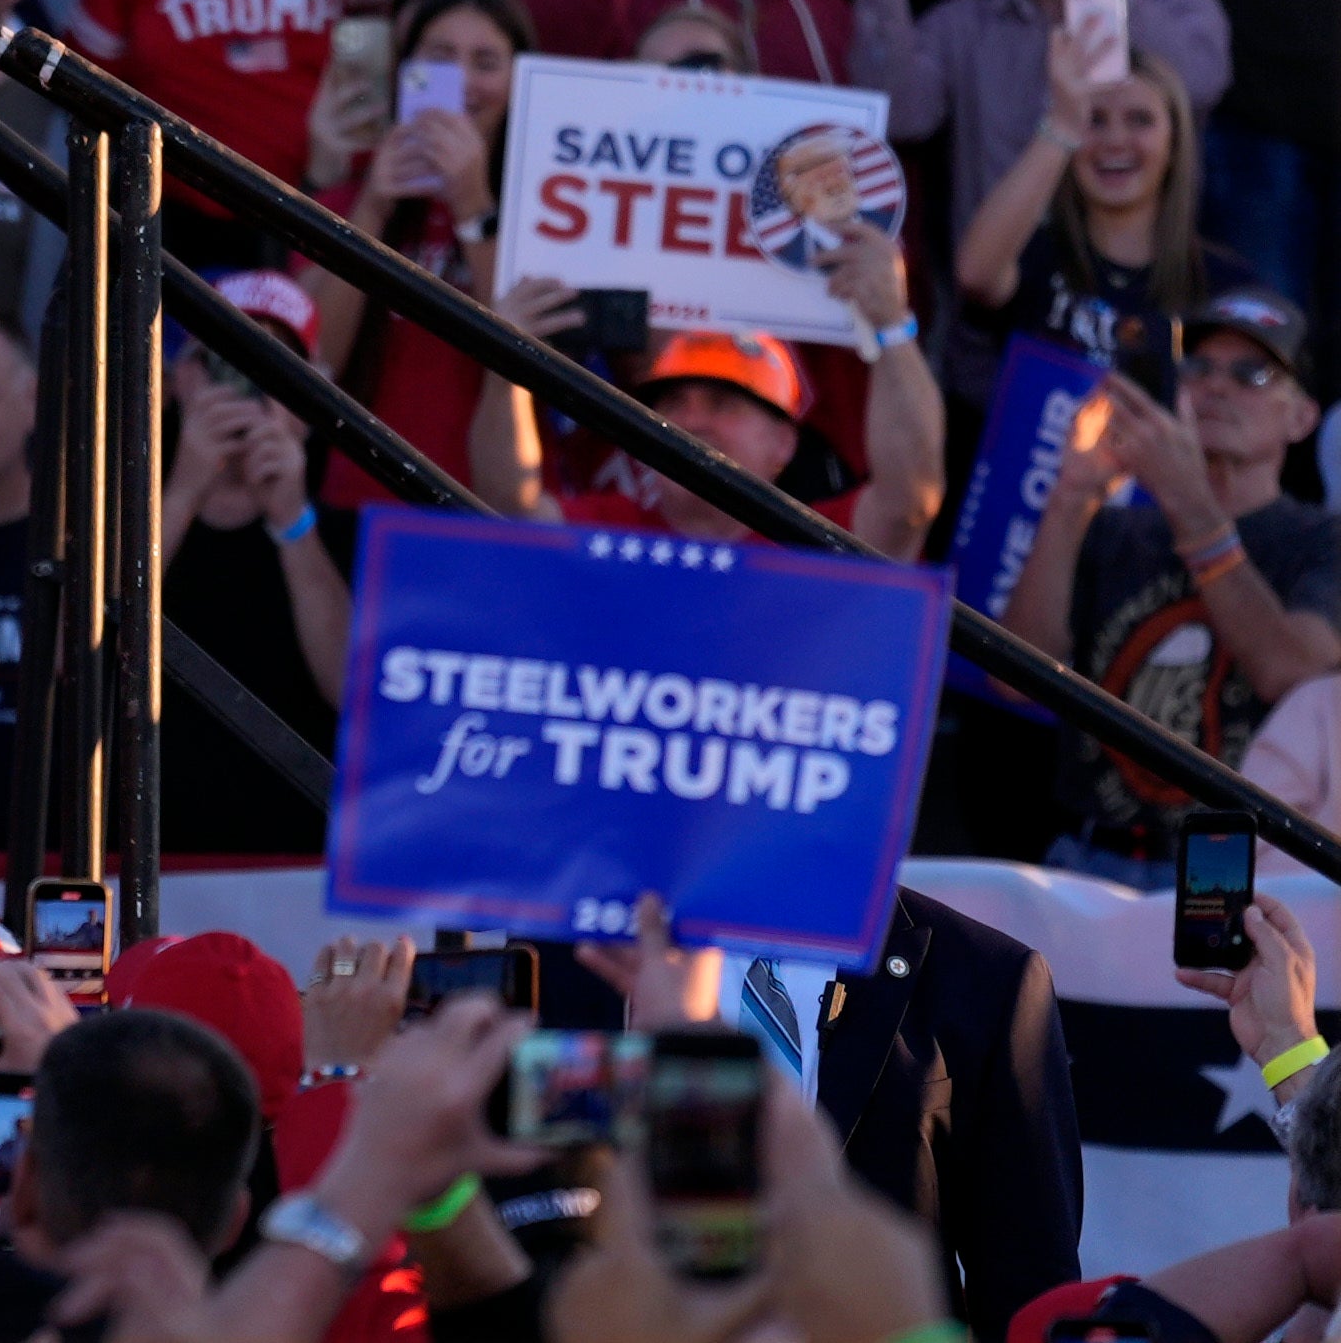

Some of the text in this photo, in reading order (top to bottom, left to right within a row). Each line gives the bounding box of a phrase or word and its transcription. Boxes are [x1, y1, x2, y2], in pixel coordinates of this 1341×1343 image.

[555, 126, 696, 177] SAVE
[533, 171, 768, 264] STE
[379, 644, 900, 758] STEELWORKERS
[415, 710, 854, 815] for TRUMP
